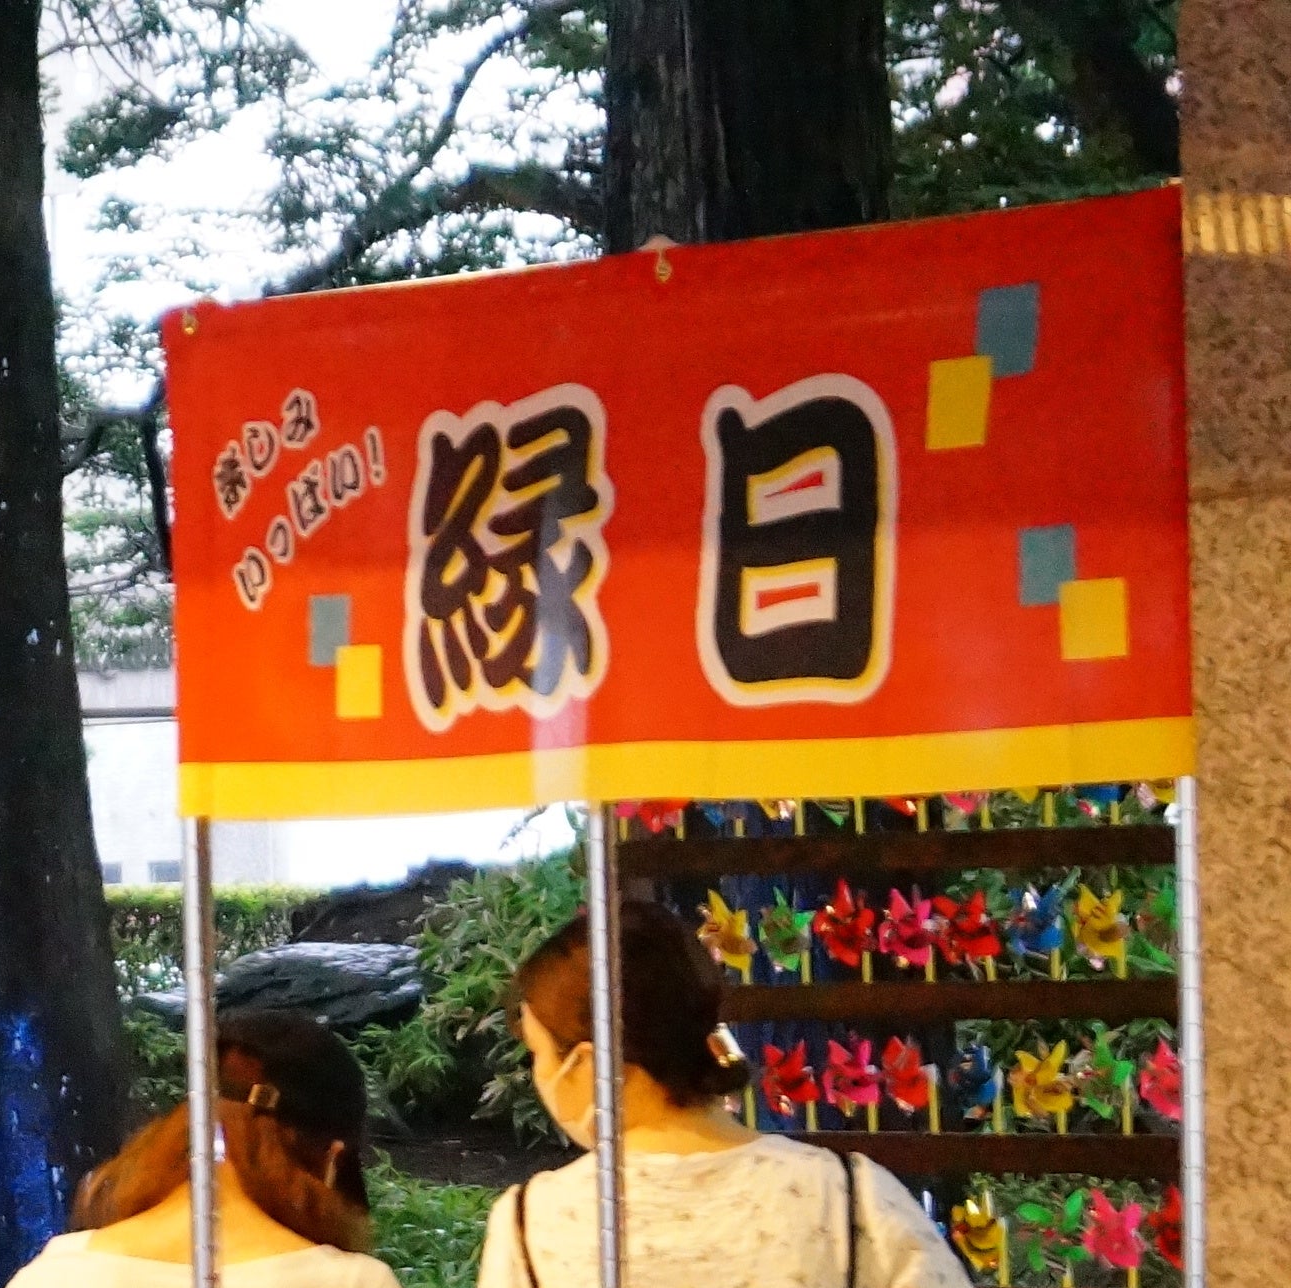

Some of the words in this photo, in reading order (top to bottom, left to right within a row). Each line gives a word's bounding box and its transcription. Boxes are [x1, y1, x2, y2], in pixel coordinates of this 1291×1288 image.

[214, 388, 318, 519] 楽しみ
[411, 378, 893, 726] 縁日
